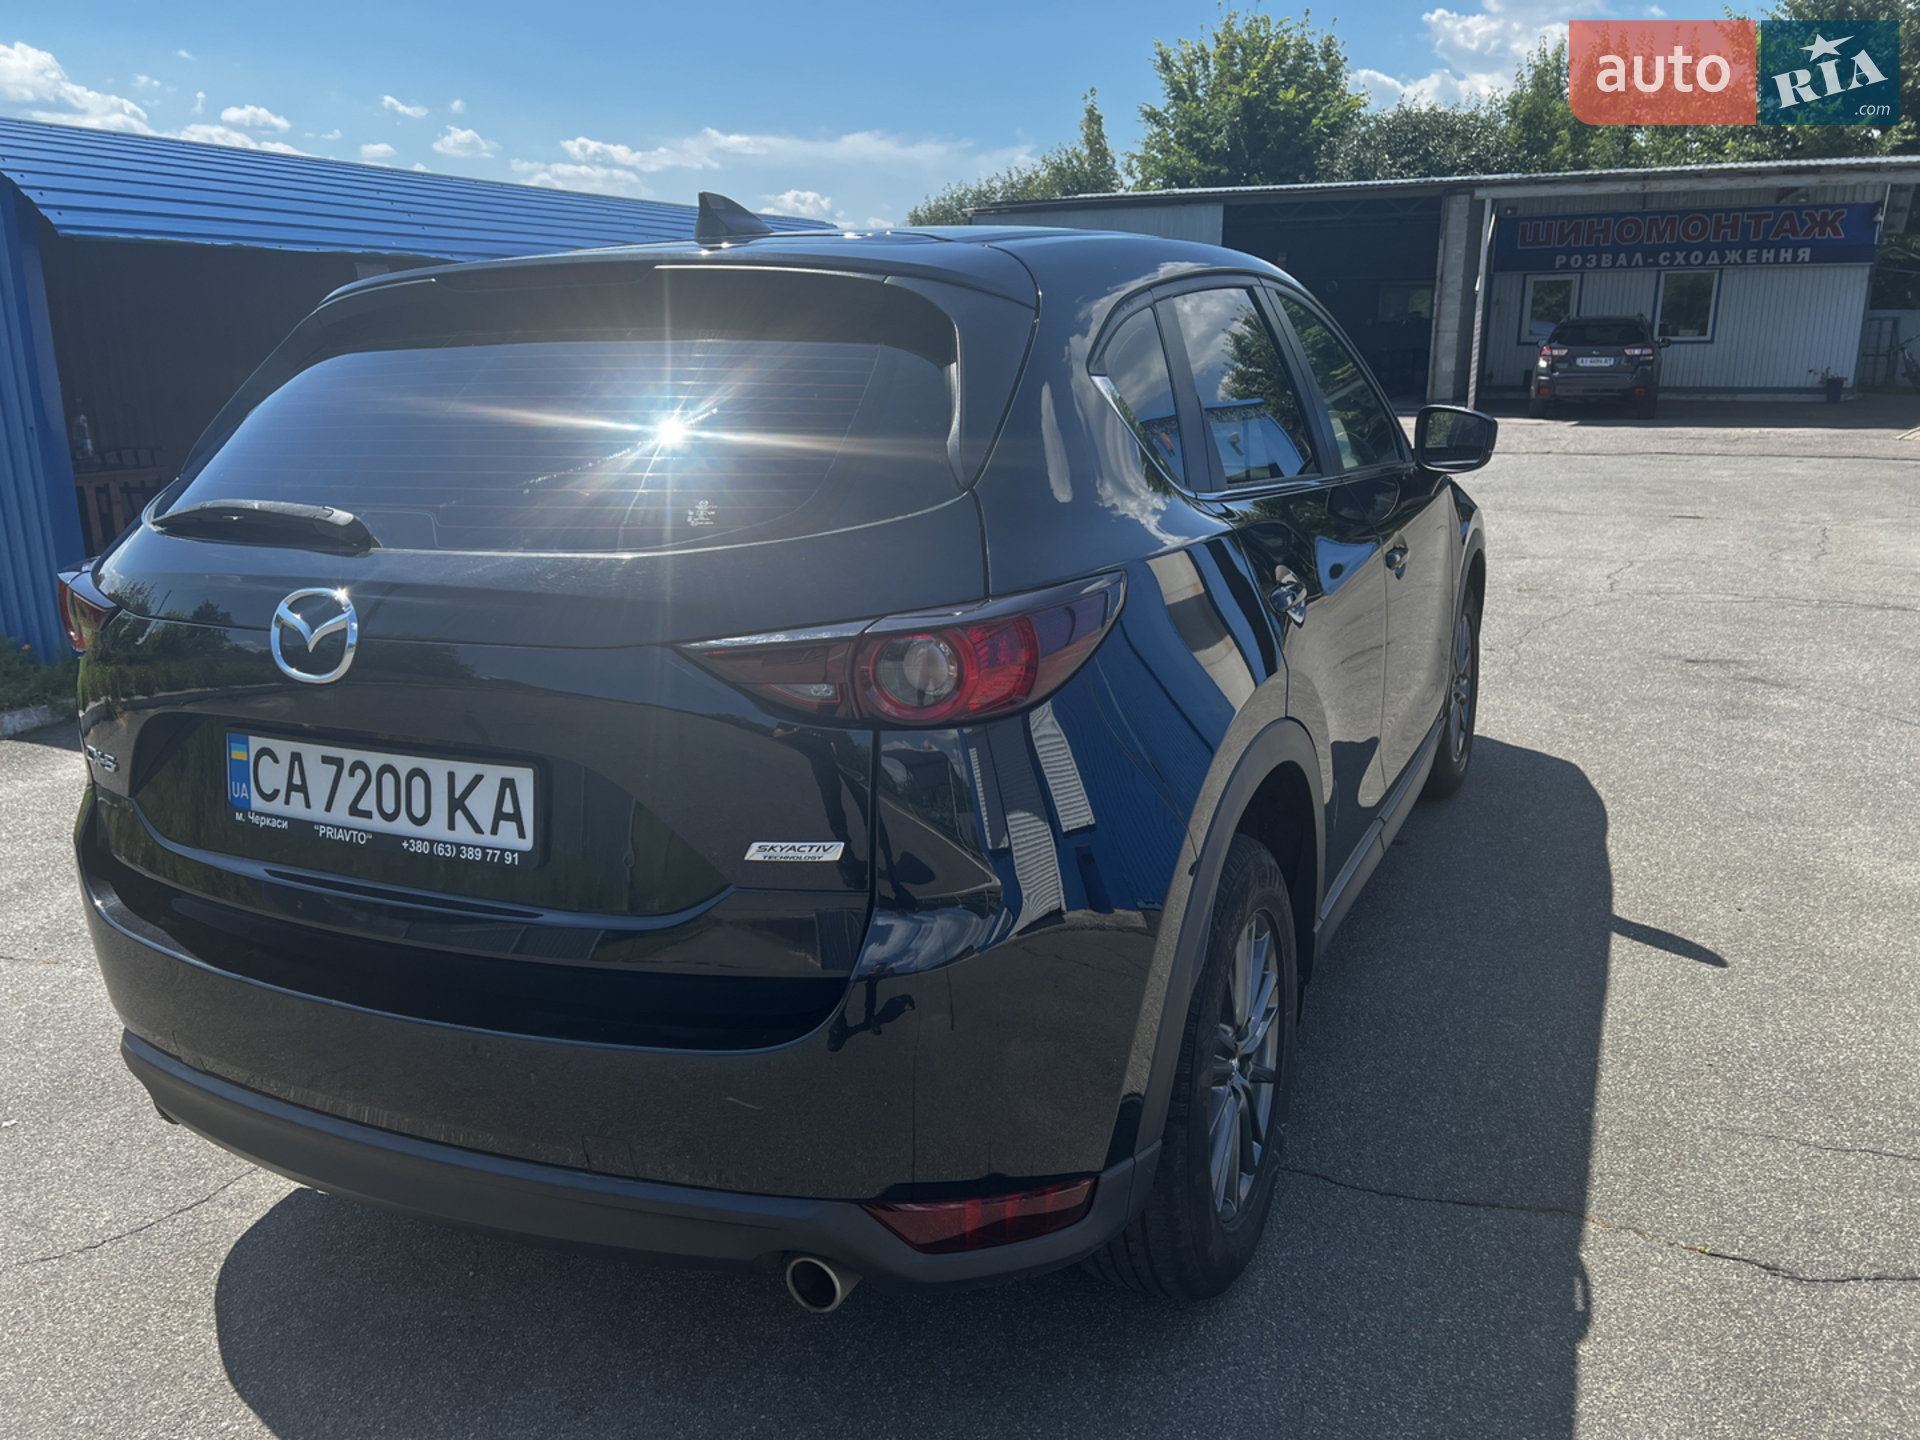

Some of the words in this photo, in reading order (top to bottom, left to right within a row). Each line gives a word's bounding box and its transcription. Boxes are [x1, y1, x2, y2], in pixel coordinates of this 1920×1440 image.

[1517, 208, 1848, 249] ШИНОМОНТАЖ
[1554, 247, 1812, 270] РОЗВАЛ-СХОДЖЕННЯ
[231, 781, 249, 800] UA
[235, 811, 246, 822] м.
[248, 810, 288, 830] Черкаси
[401, 839, 430, 855] +380
[433, 842, 456, 858] (63)
[459, 846, 482, 861] 389
[485, 848, 501, 863] 77
[504, 851, 519, 866] 91
[756, 845, 833, 853] SKYACTIV
